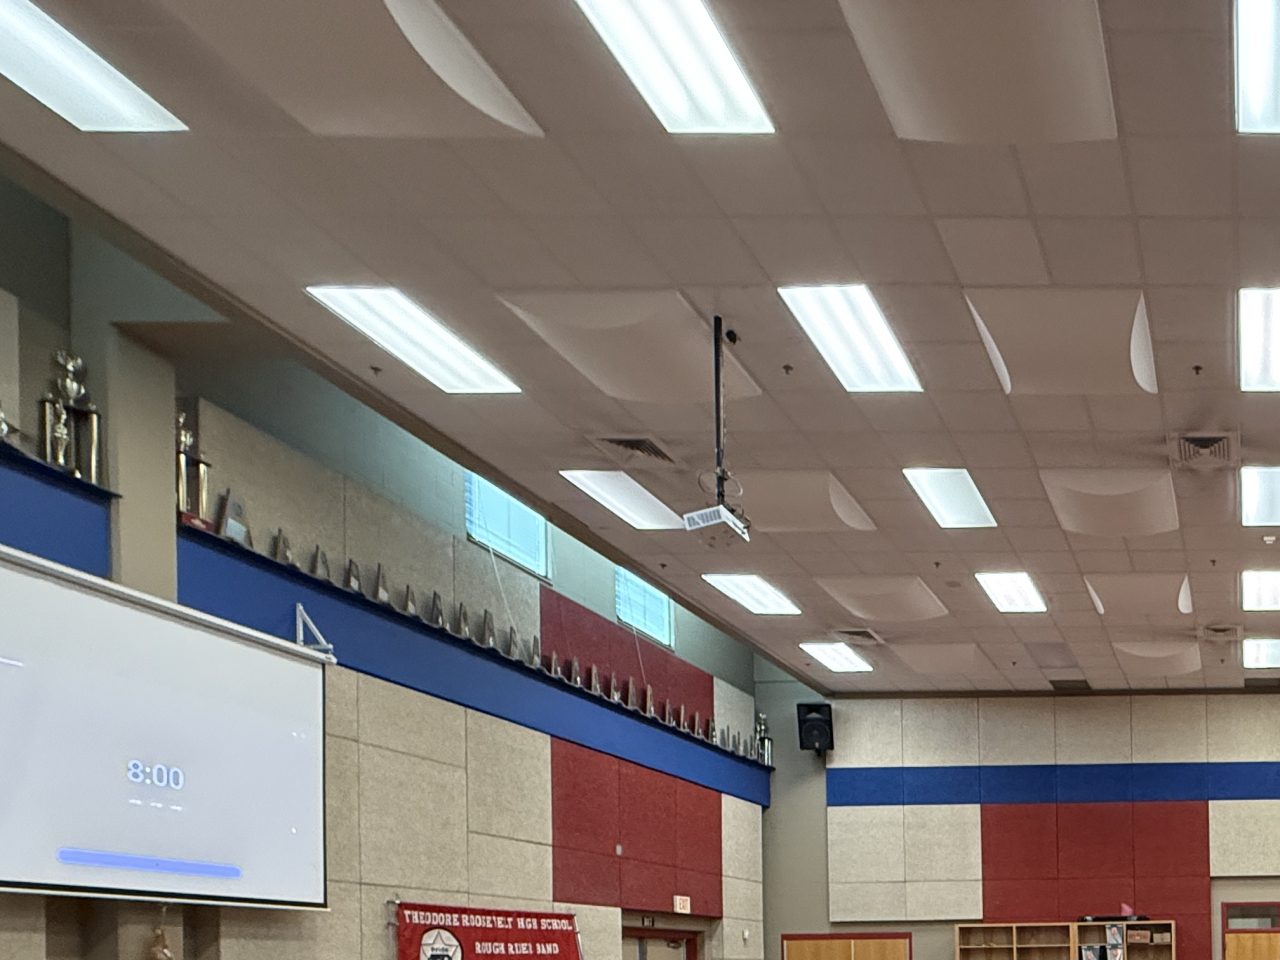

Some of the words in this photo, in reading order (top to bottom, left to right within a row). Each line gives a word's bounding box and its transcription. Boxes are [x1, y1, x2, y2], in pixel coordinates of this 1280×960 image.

[127, 760, 184, 790] 8:00
[403, 910, 460, 926] THEODORE
[517, 917, 538, 930] HGH
[475, 941, 506, 955] ROUGH
